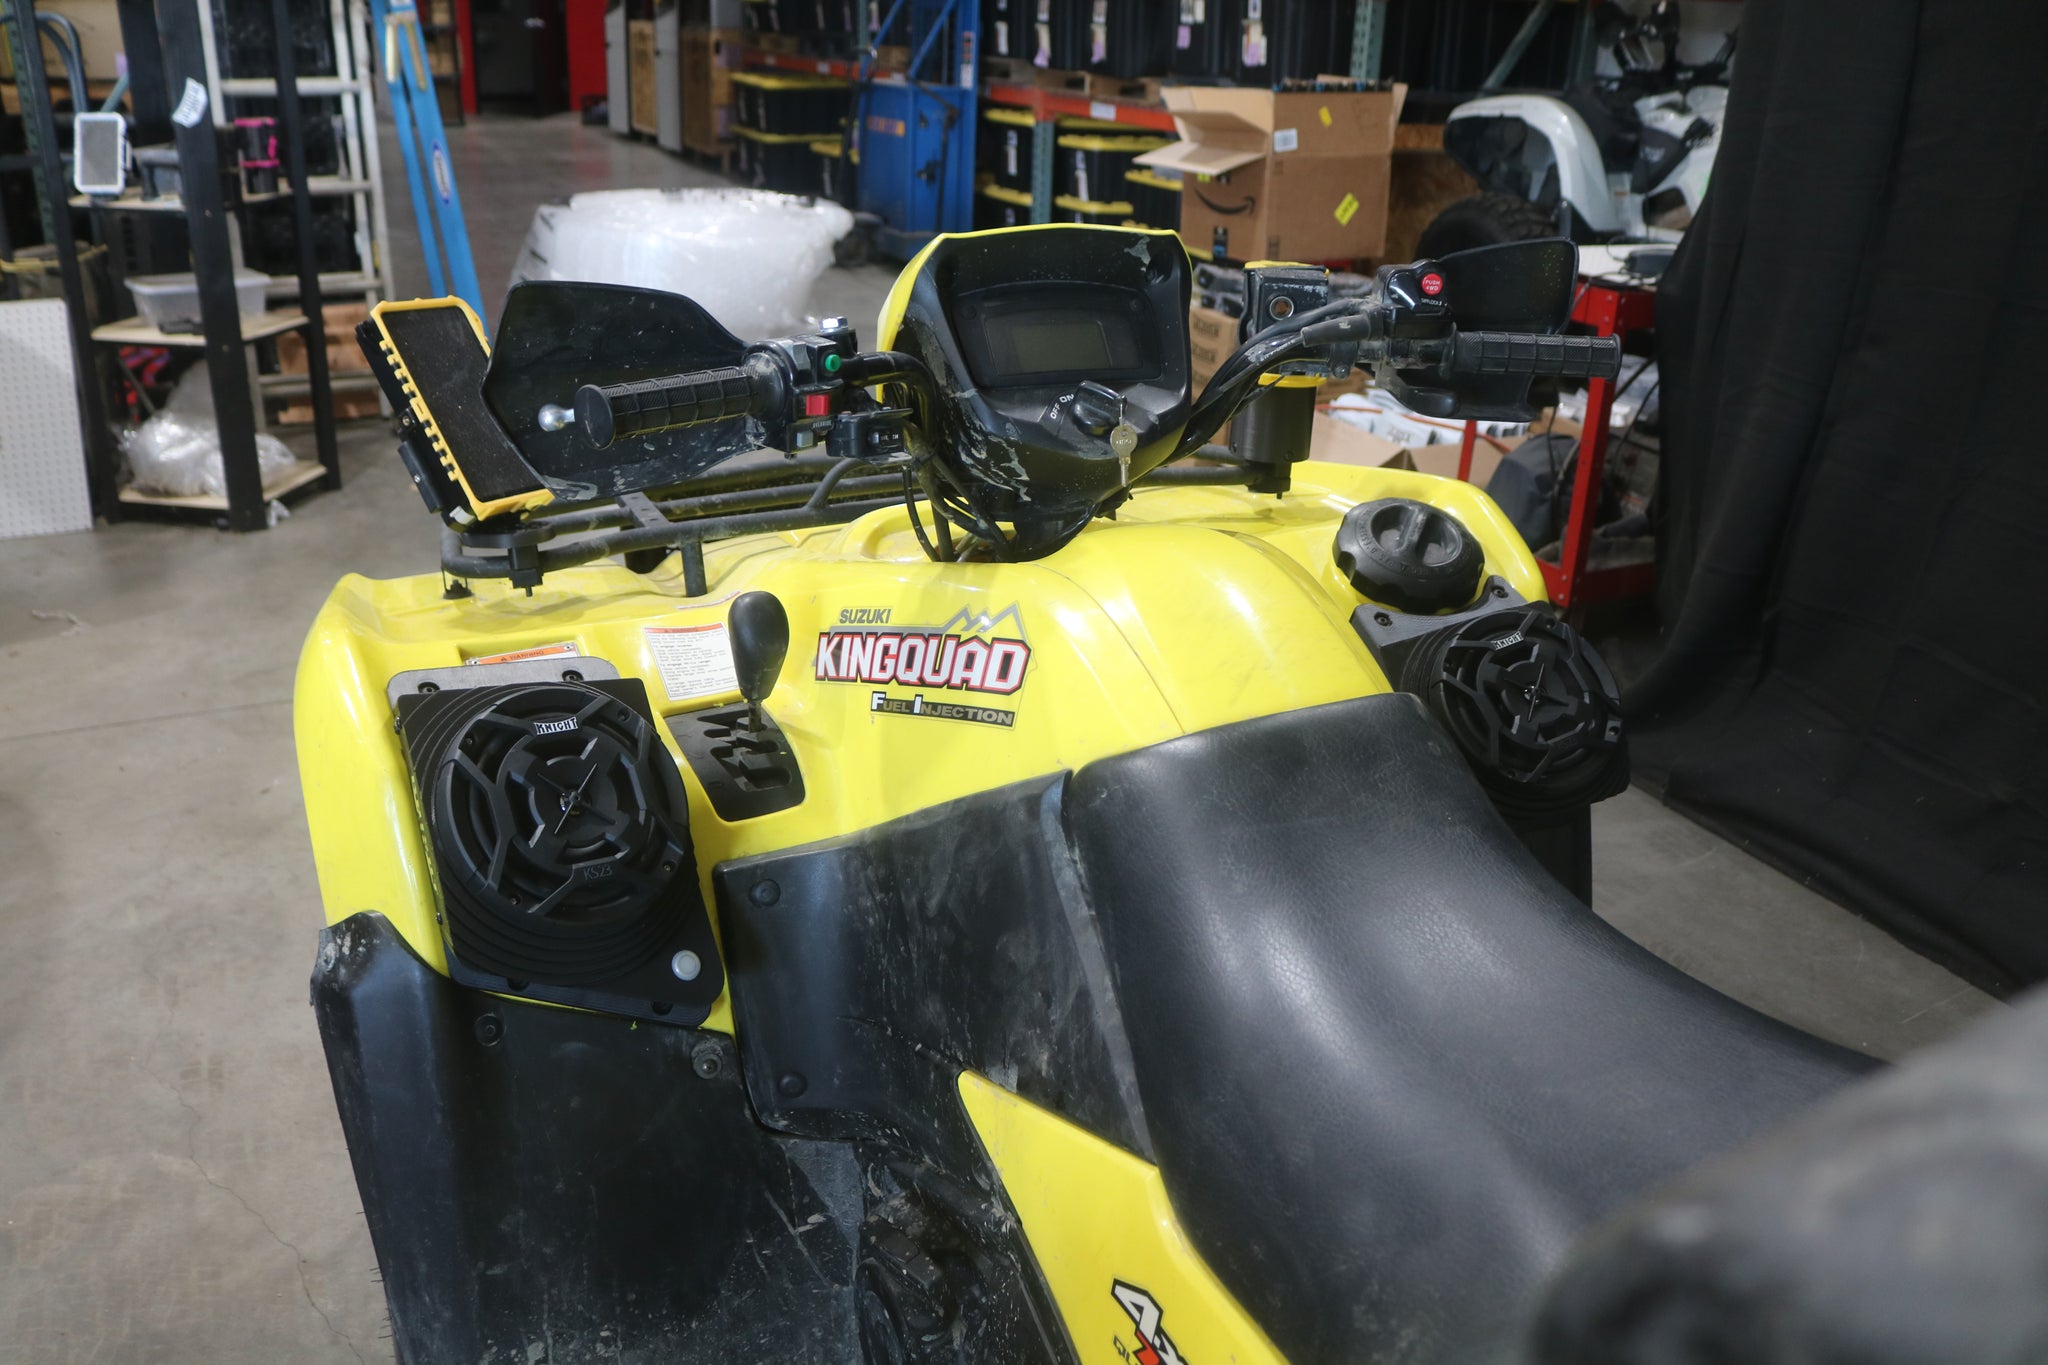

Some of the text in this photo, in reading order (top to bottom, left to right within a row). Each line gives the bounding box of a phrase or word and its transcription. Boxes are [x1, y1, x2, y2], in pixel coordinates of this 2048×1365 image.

[1059, 393, 1075, 403] ON
[1050, 402, 1061, 420] OFF
[839, 608, 892, 624] SUZUKI
[1492, 630, 1524, 651] KNIGHT
[815, 632, 1032, 695] KINGQUAD
[871, 691, 1015, 727] FUEL INJECTION
[535, 717, 578, 735] KNIGHT
[583, 864, 613, 881] KS23
